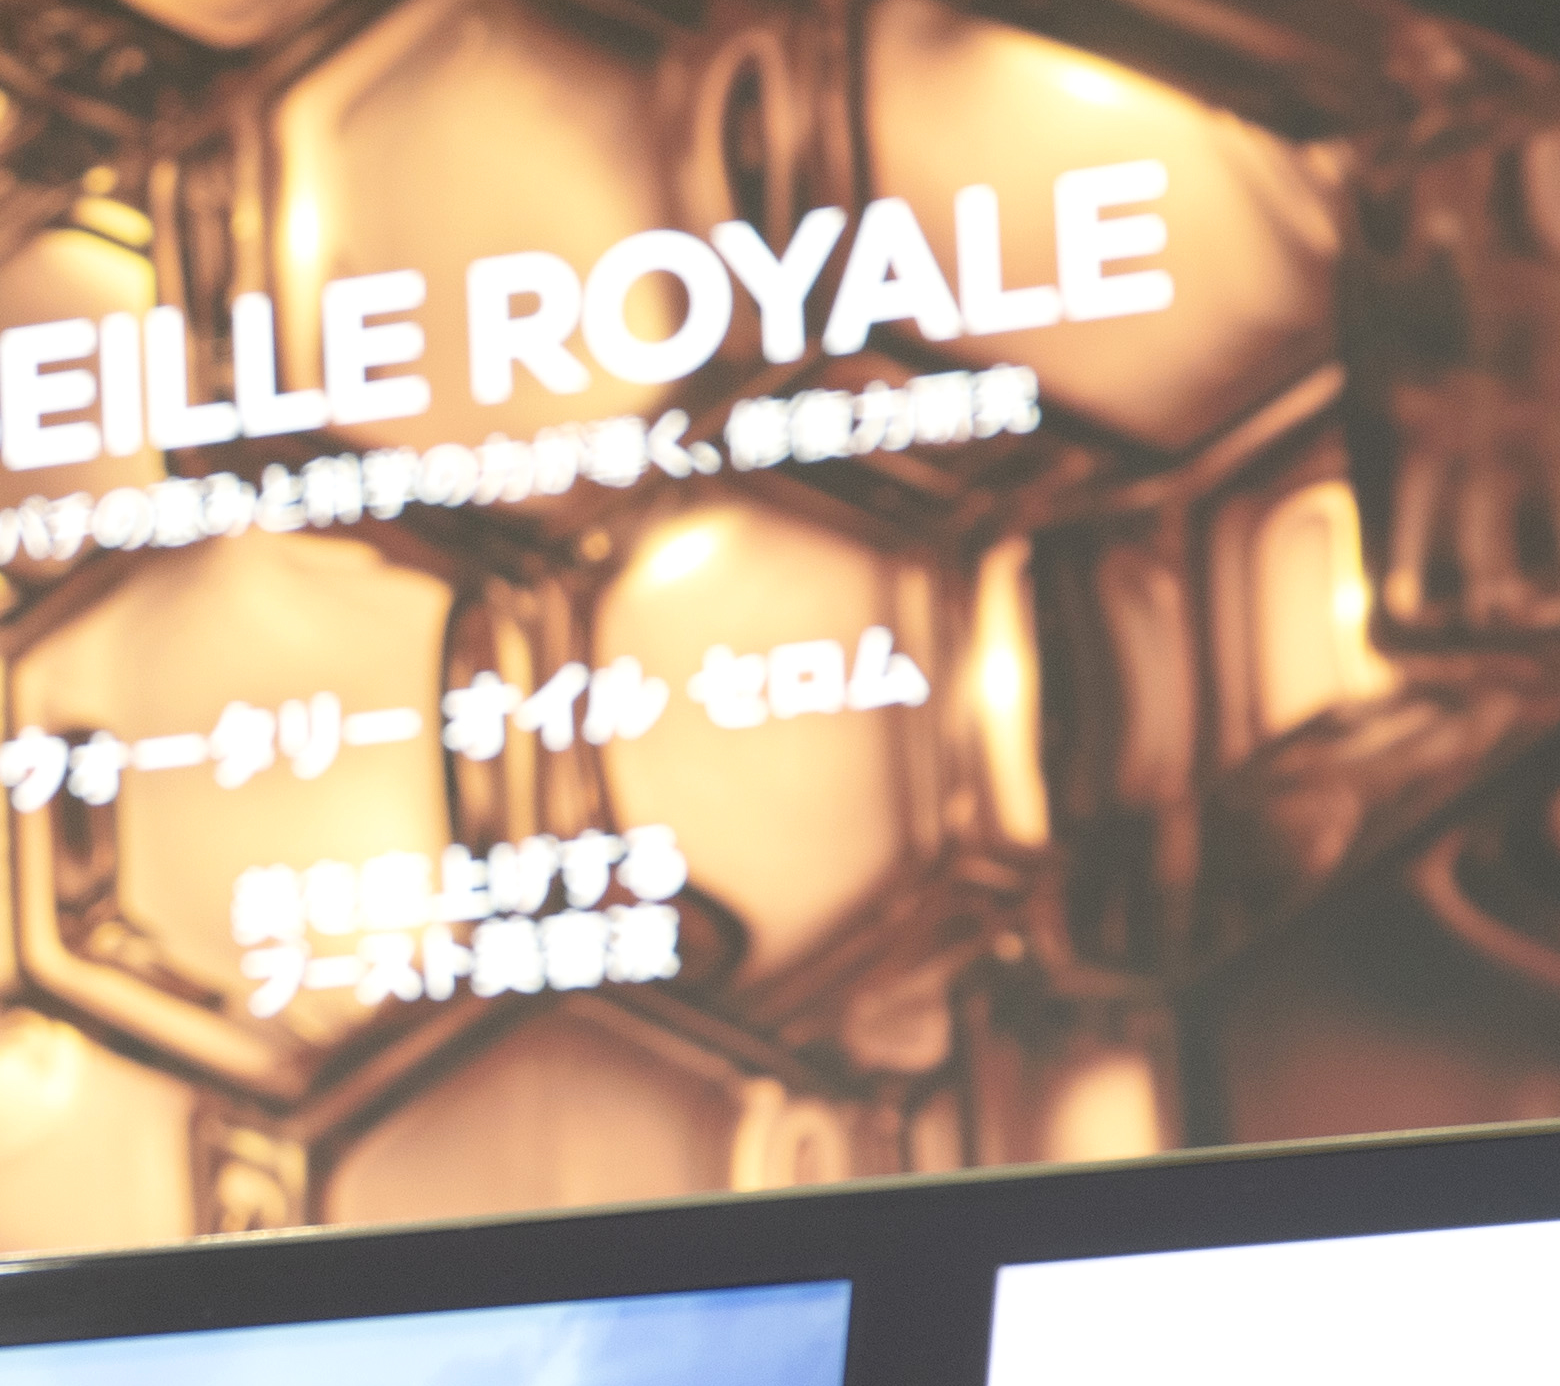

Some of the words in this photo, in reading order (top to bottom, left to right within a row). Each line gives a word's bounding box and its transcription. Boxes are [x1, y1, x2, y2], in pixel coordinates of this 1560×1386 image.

[464, 159, 1175, 406] ROYALE
[441, 657, 669, 763] オイル
[688, 627, 930, 728] セロム
